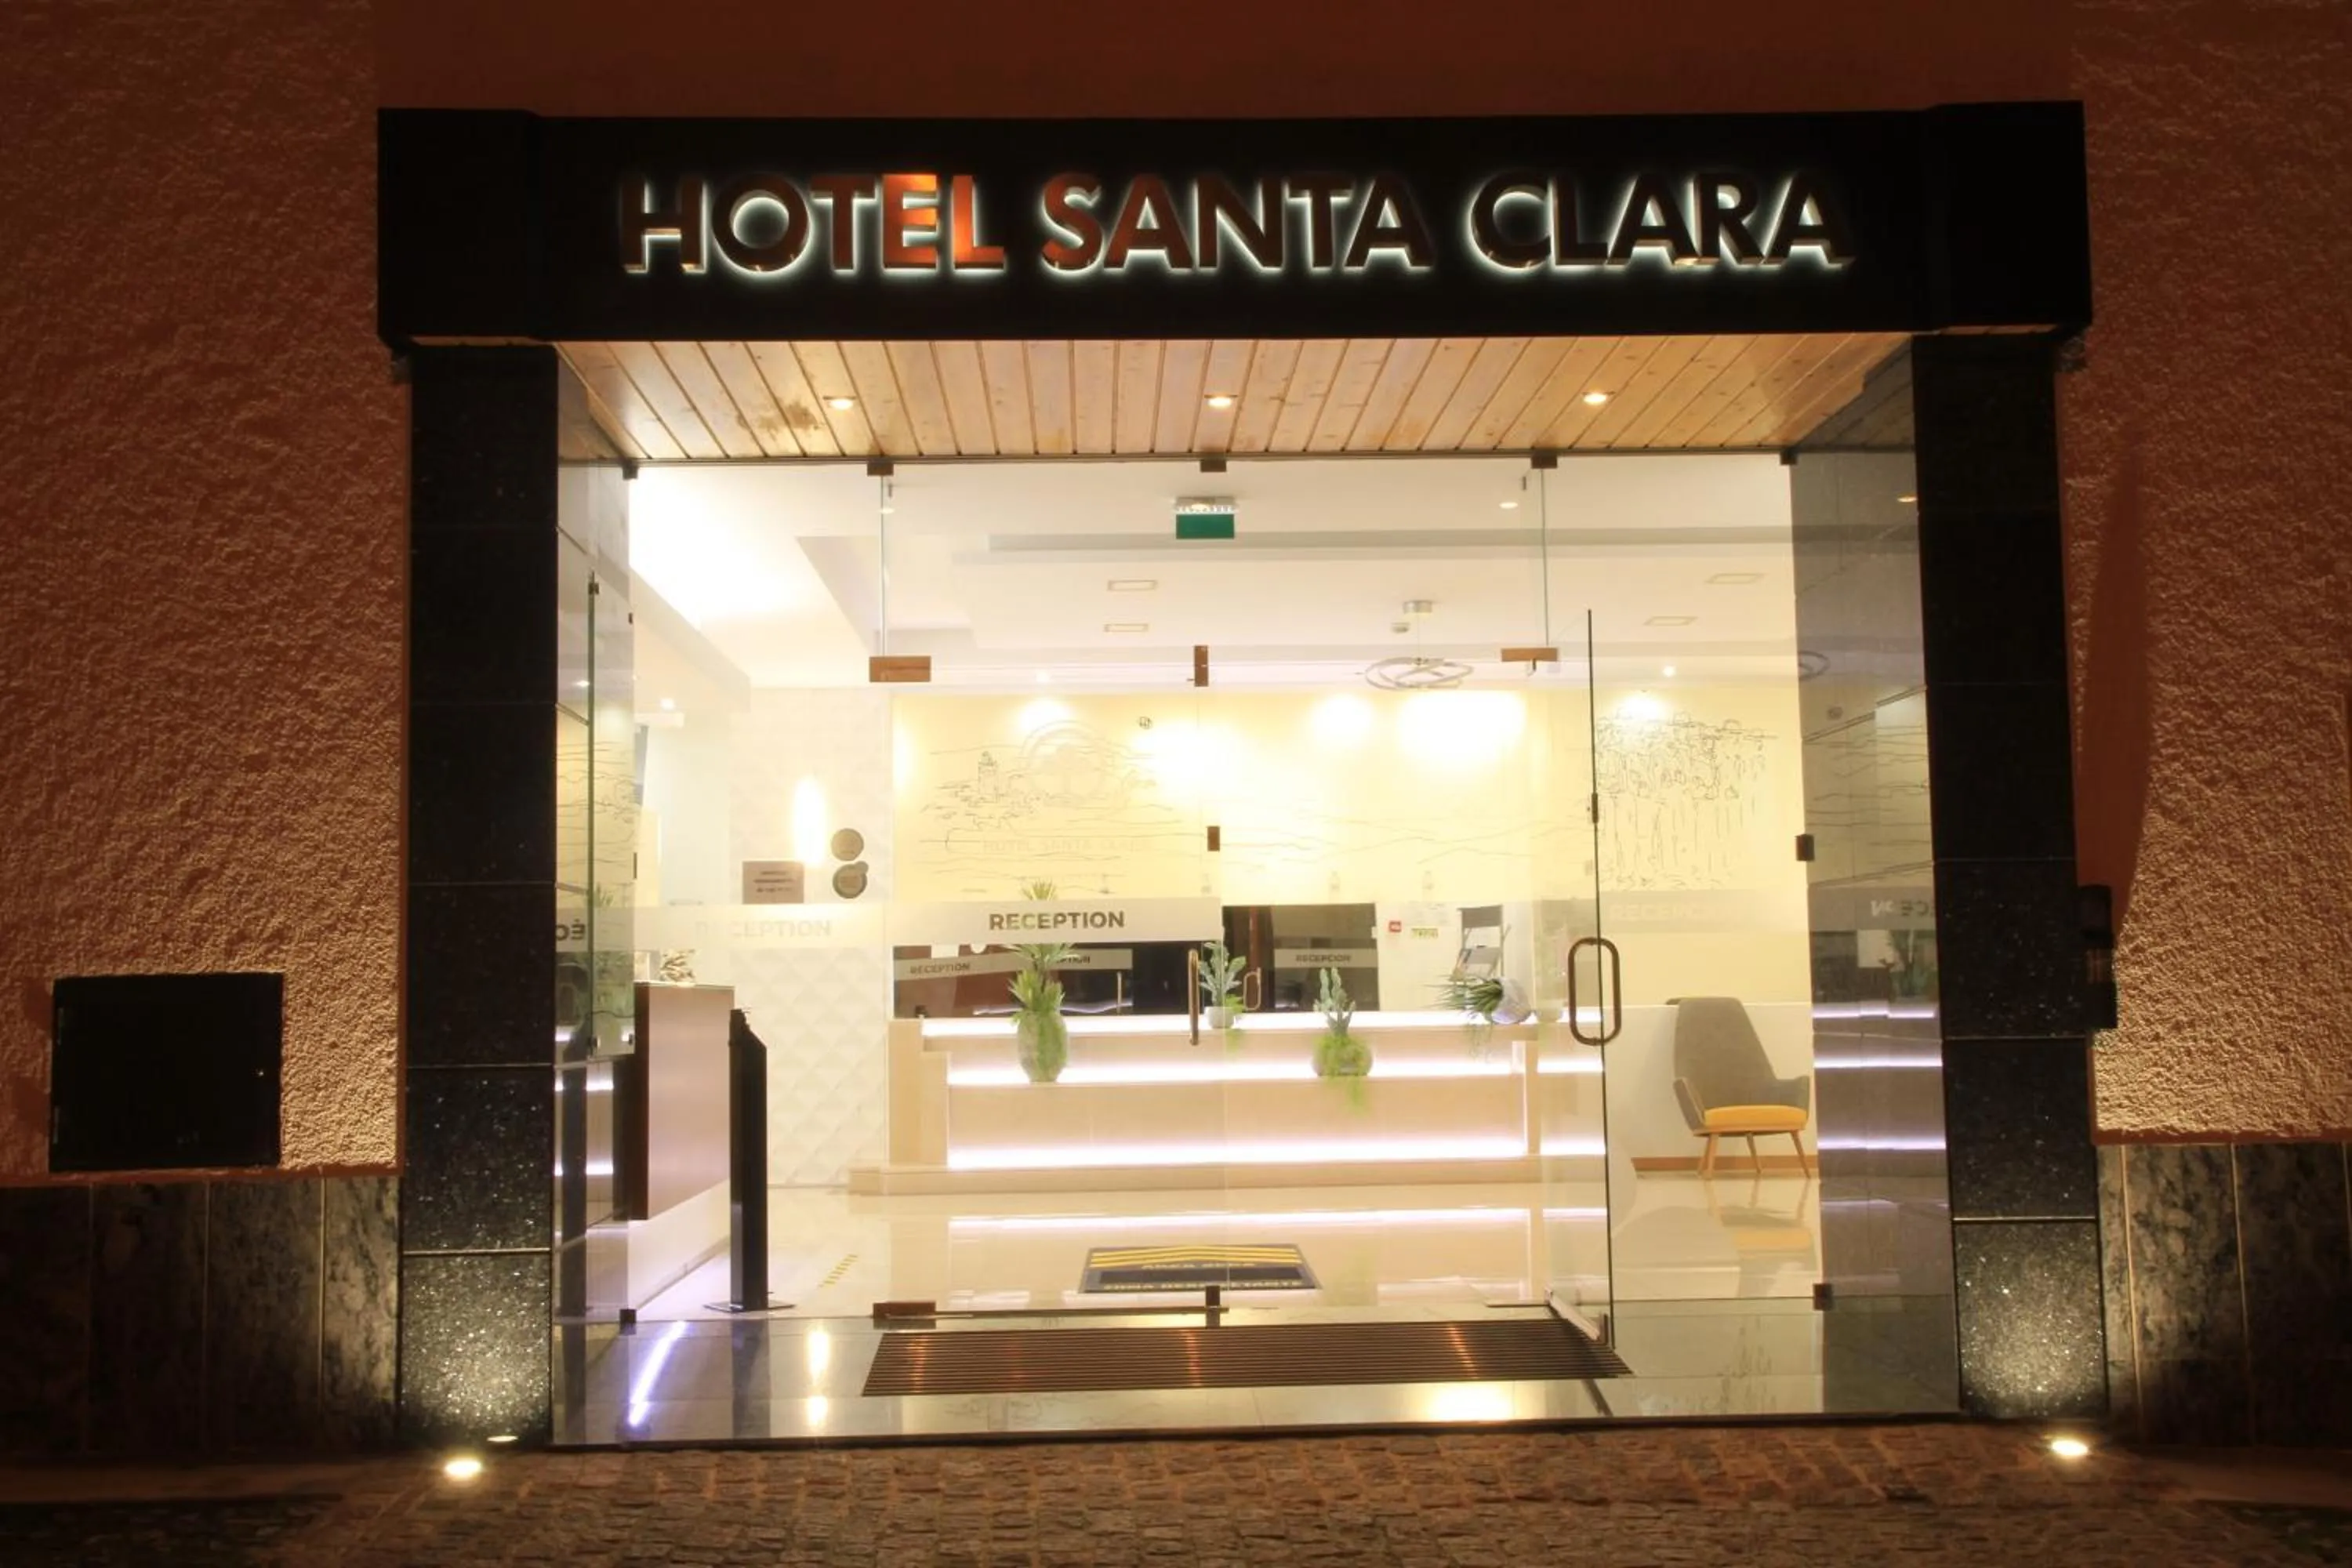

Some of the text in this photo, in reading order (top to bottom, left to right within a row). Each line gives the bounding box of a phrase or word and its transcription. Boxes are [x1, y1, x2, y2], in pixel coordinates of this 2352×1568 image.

[622, 172, 1856, 273] HOTEL SANTA CLARA
[695, 920, 832, 937] RCEPTION
[989, 910, 1124, 931] RECEPTION
